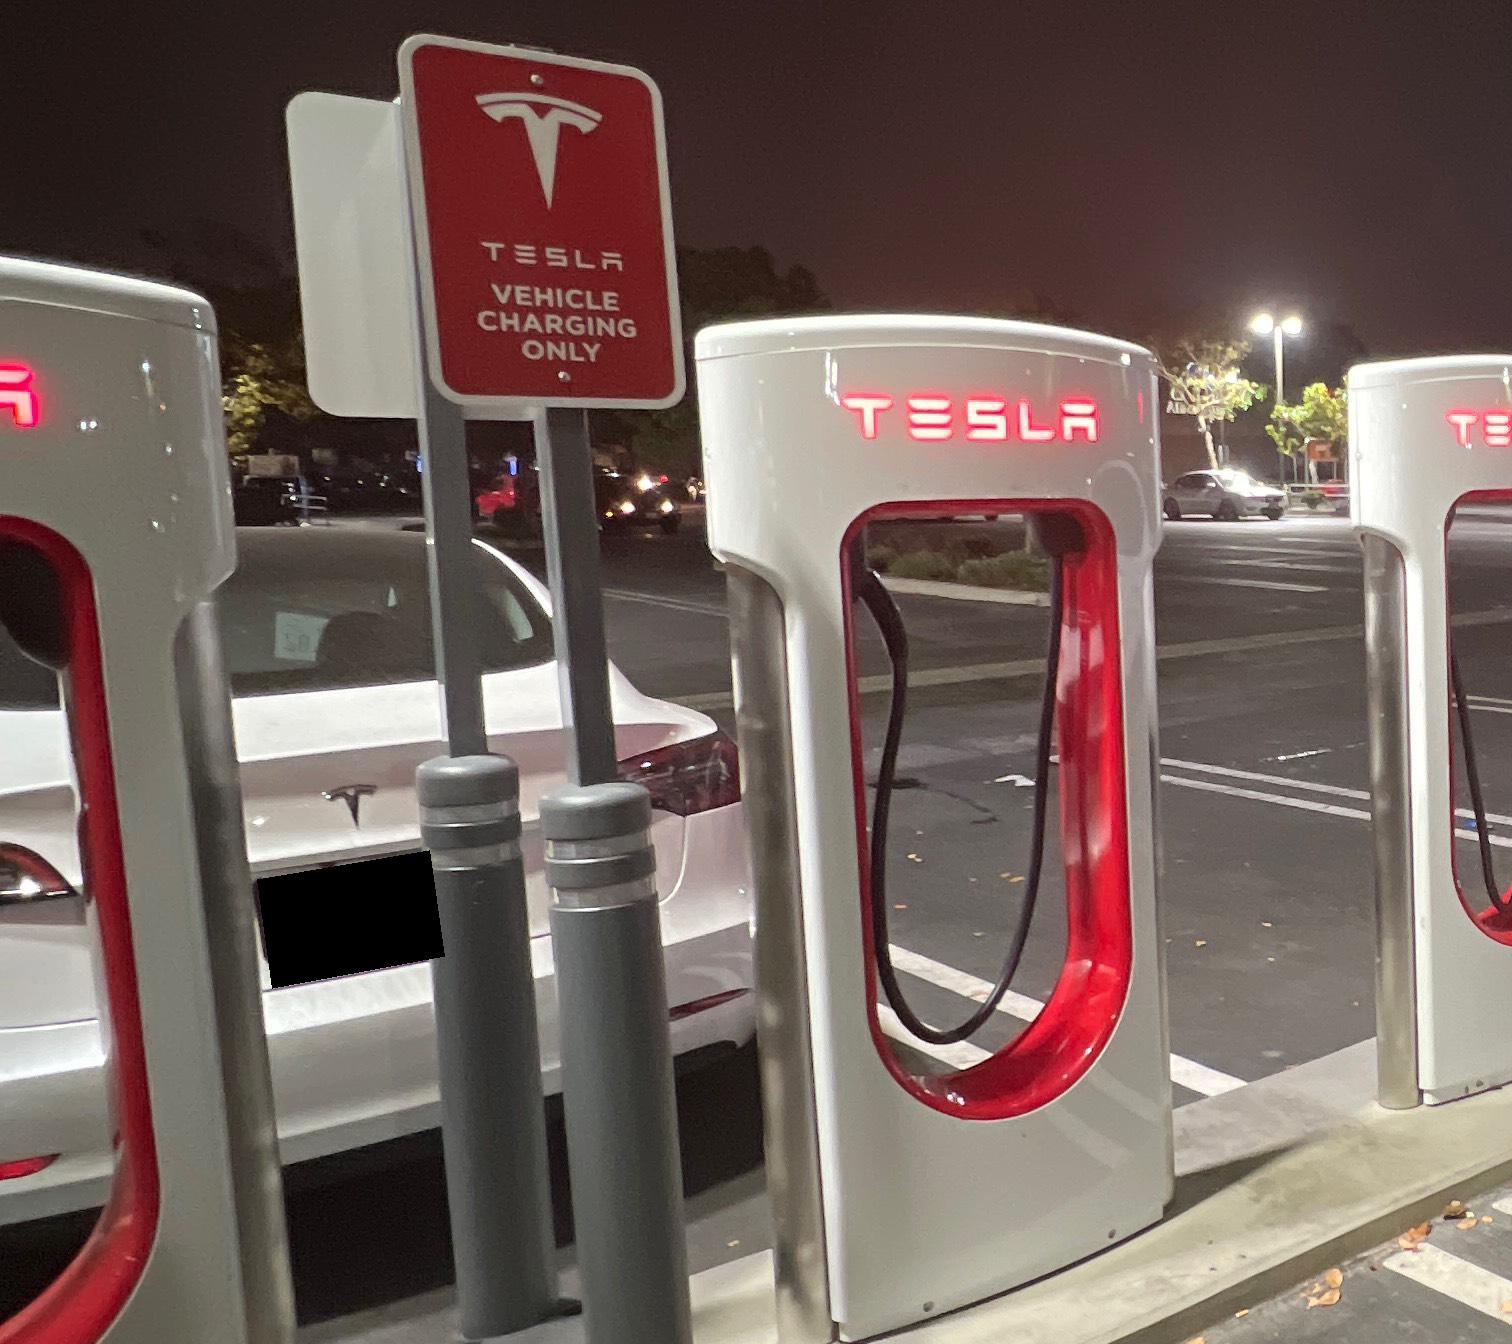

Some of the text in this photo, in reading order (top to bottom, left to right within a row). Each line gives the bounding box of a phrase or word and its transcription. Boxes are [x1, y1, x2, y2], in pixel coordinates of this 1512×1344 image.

[481, 240, 623, 272] TESLA
[490, 283, 621, 312] VEHICLE
[477, 310, 637, 339] CHARGING
[521, 339, 602, 363] ONLY
[841, 395, 1099, 443] TESLA
